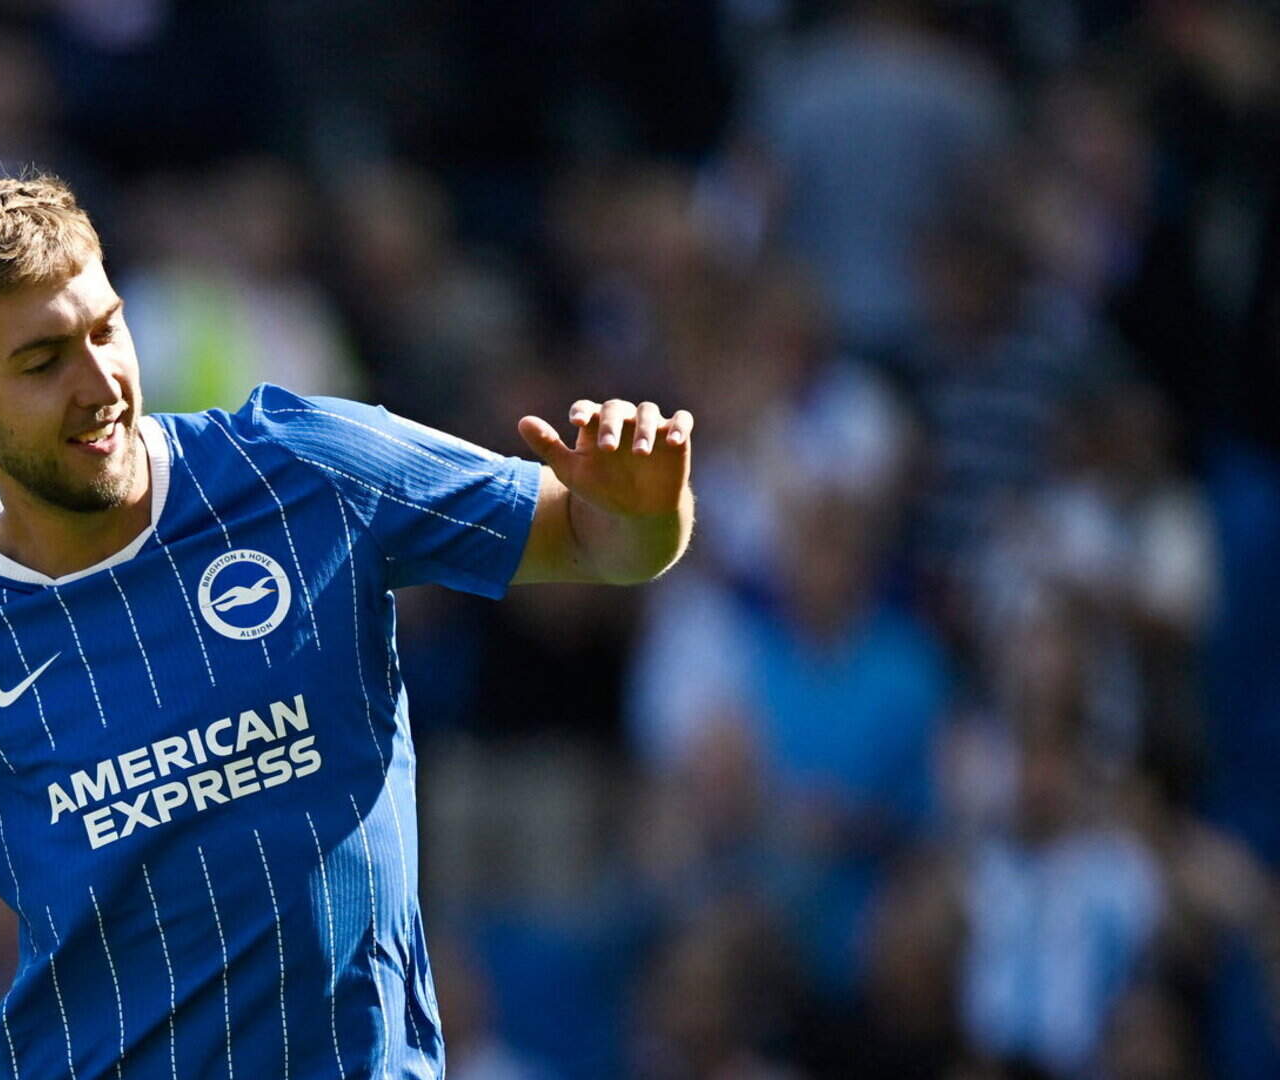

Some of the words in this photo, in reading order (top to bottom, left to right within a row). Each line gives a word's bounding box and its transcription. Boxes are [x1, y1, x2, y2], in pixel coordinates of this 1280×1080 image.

[202, 553, 237, 588] BRIGHTON
[240, 552, 246, 560] &
[248, 553, 273, 568] HOVE
[240, 622, 273, 638] ALBION
[47, 694, 310, 825] AMERICAN
[83, 735, 322, 850] EXPRESS
